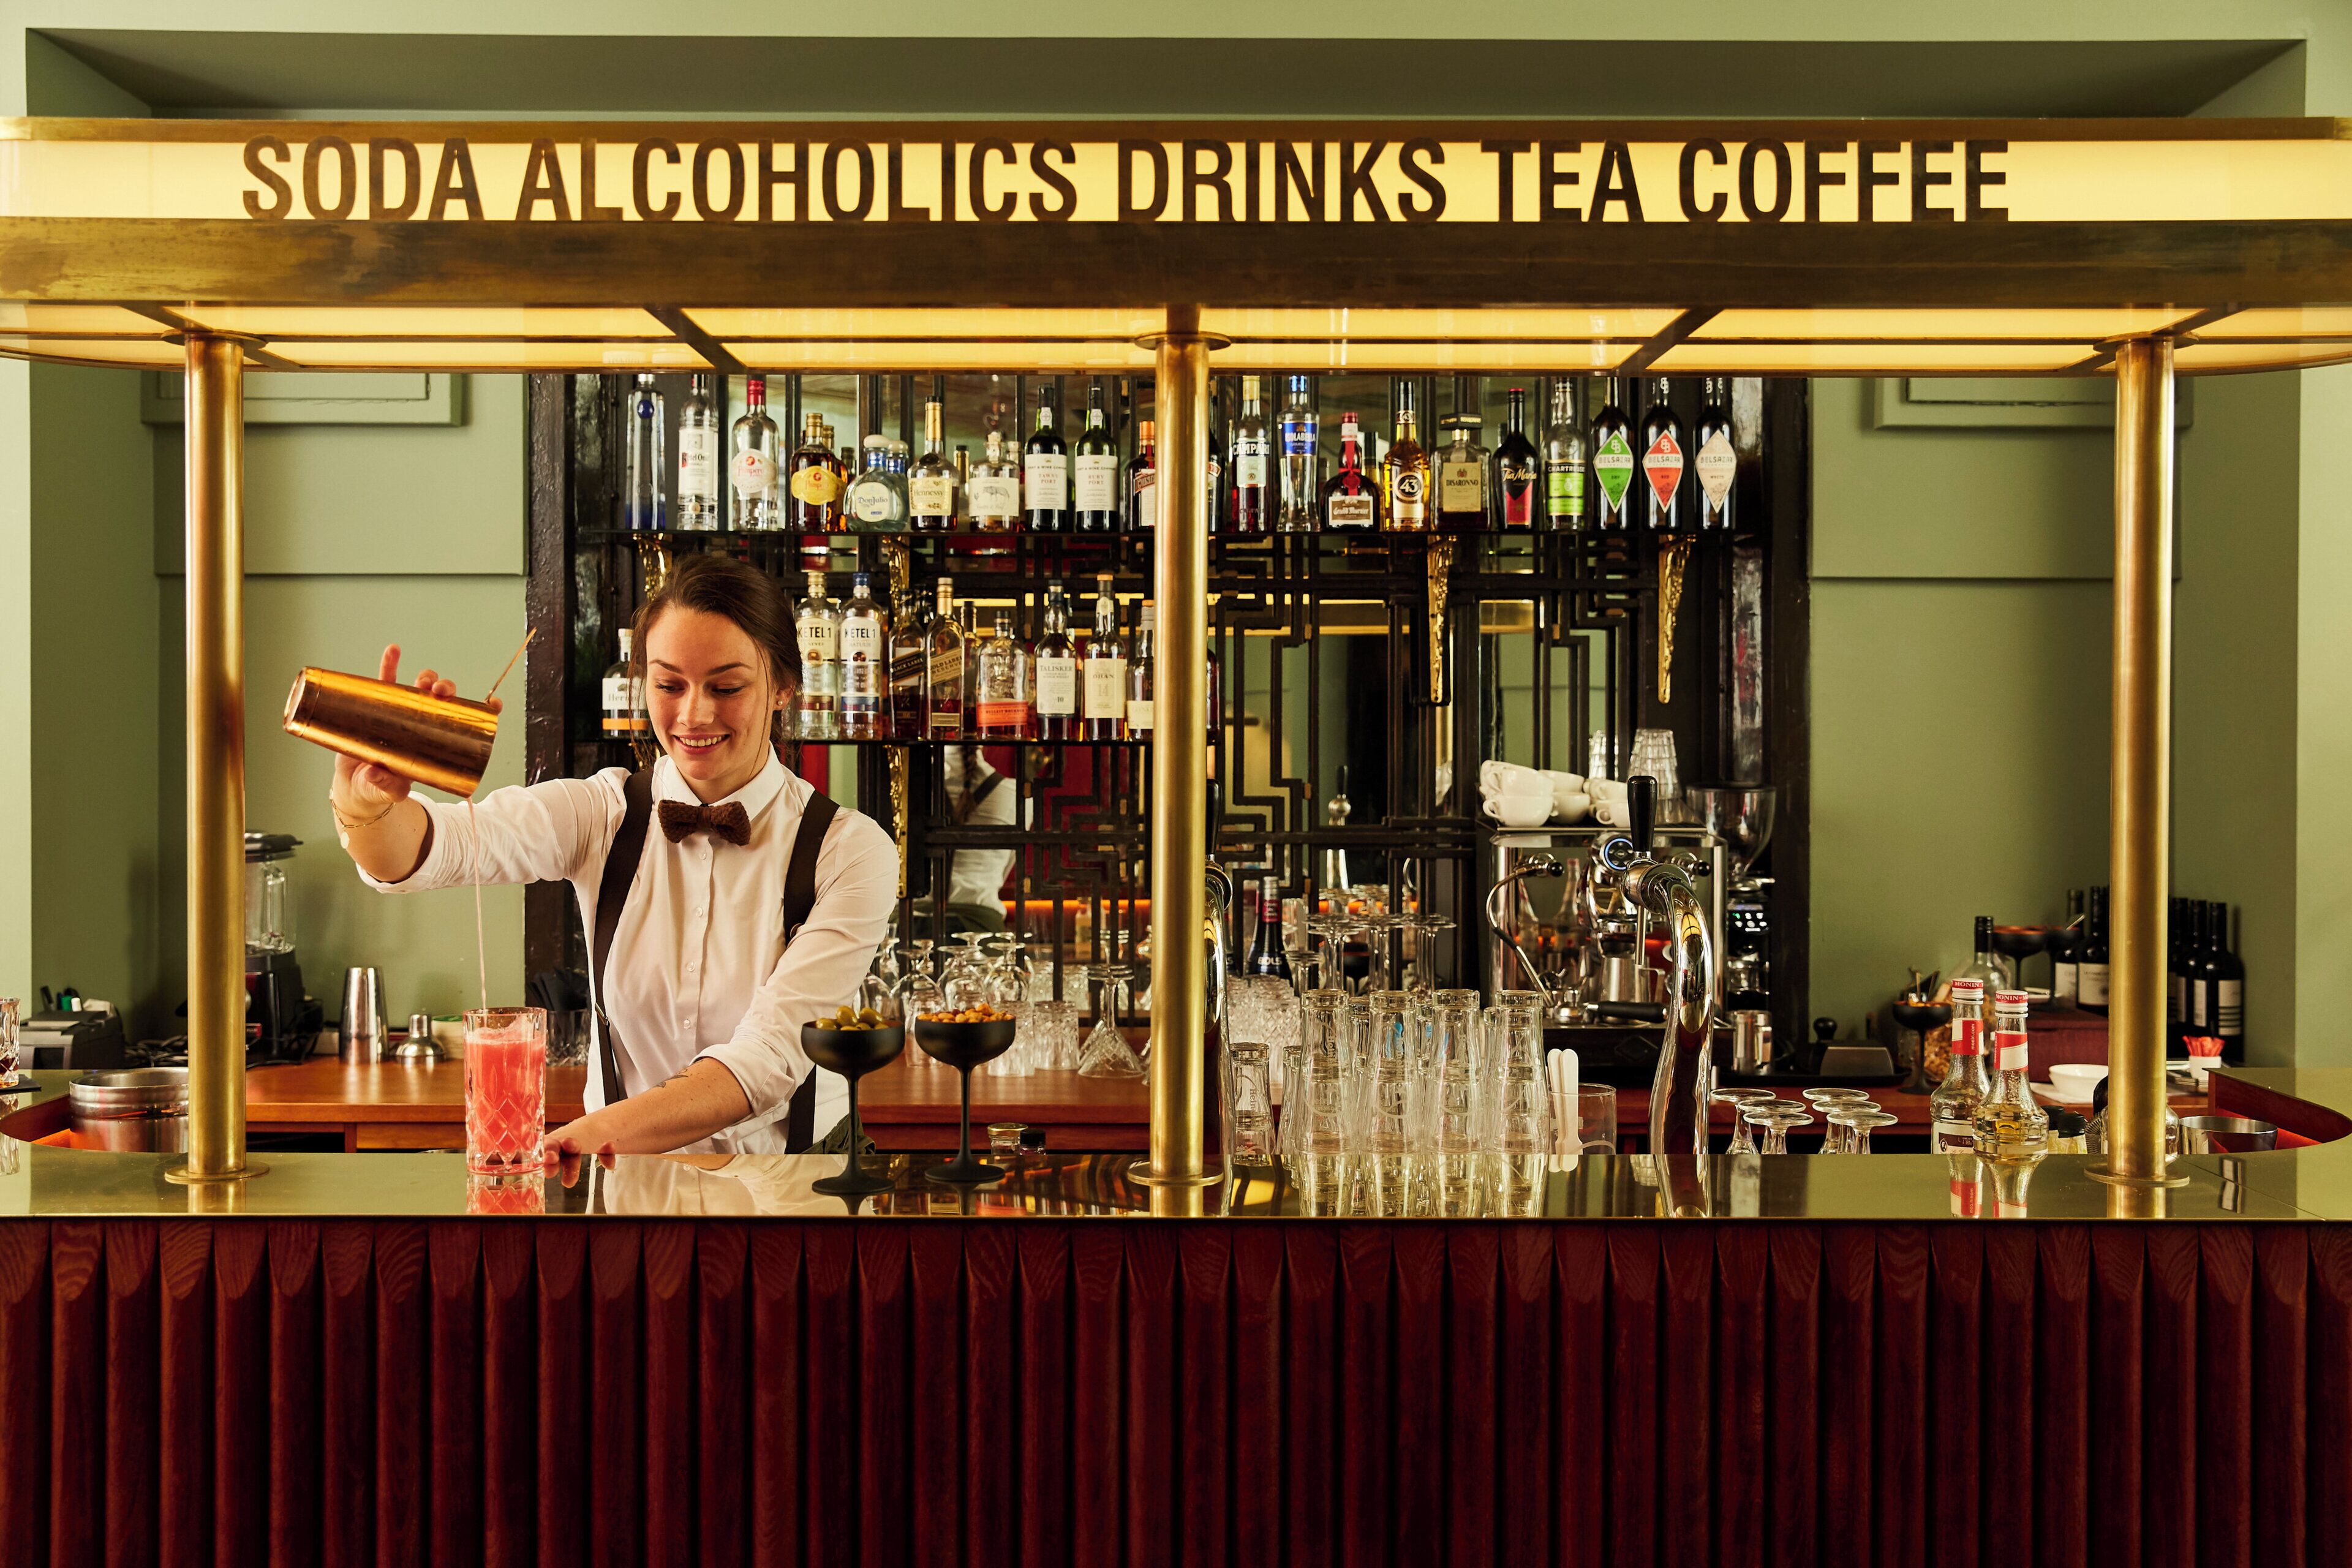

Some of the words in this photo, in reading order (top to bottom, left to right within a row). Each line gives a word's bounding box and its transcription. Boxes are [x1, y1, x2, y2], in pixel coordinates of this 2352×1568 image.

[243, 134, 484, 221] SODA
[515, 136, 1077, 222] ALCOHOLICS
[1118, 137, 1446, 222] DRINKS
[1480, 138, 1645, 222] TEA
[1679, 137, 2009, 222] COFFEE
[1232, 443, 1270, 456] CAMPARI
[1399, 479, 1419, 493] 43
[1257, 956, 1283, 966] BOLS
